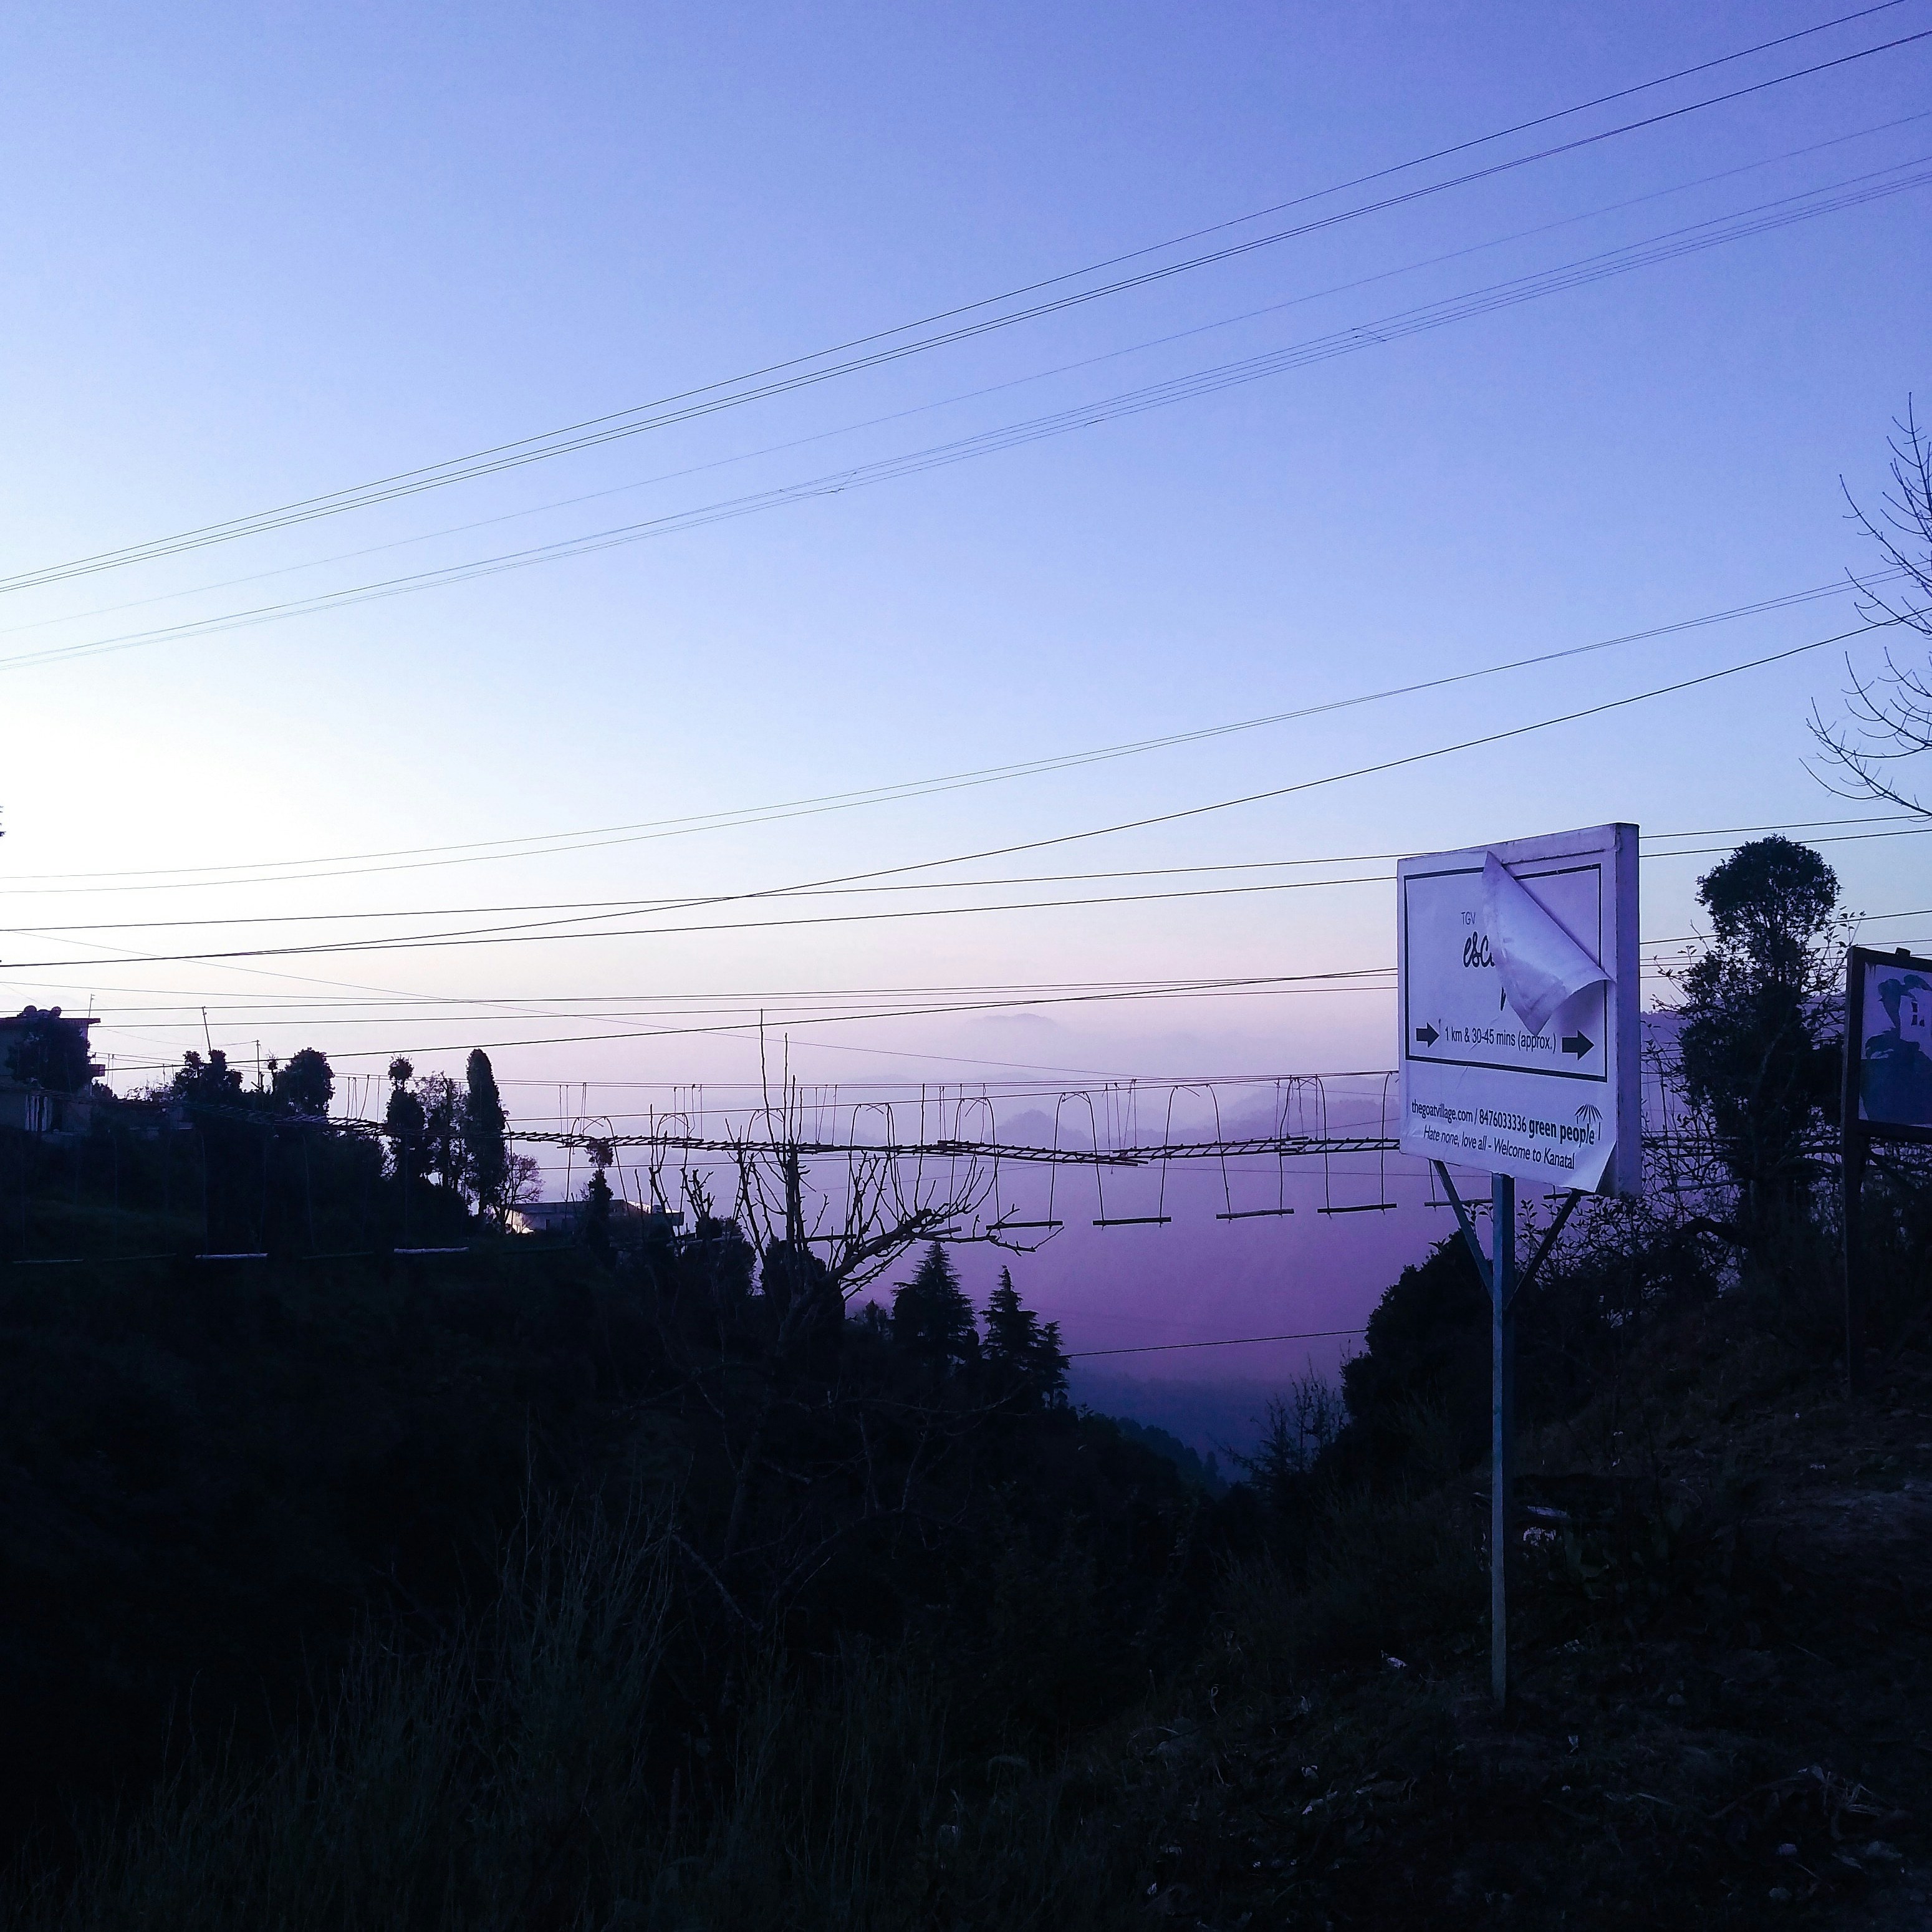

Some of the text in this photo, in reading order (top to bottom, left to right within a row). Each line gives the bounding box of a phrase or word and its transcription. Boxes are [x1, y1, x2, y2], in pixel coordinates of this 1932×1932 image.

[1461, 911, 1476, 925] TGV
[1445, 1026, 1556, 1054] 1 km & 30-45 mins (approx.)
[1411, 1098, 1595, 1148] thegoatvillage.com / 8476033336 green people
[1423, 1124, 1440, 1141] Hate
[1441, 1132, 1460, 1148] none,
[1461, 1132, 1477, 1150] love
[1478, 1135, 1487, 1151] all
[1494, 1137, 1531, 1160] Welcome
[1532, 1148, 1542, 1163] to
[1544, 1147, 1575, 1170] Kanatal
